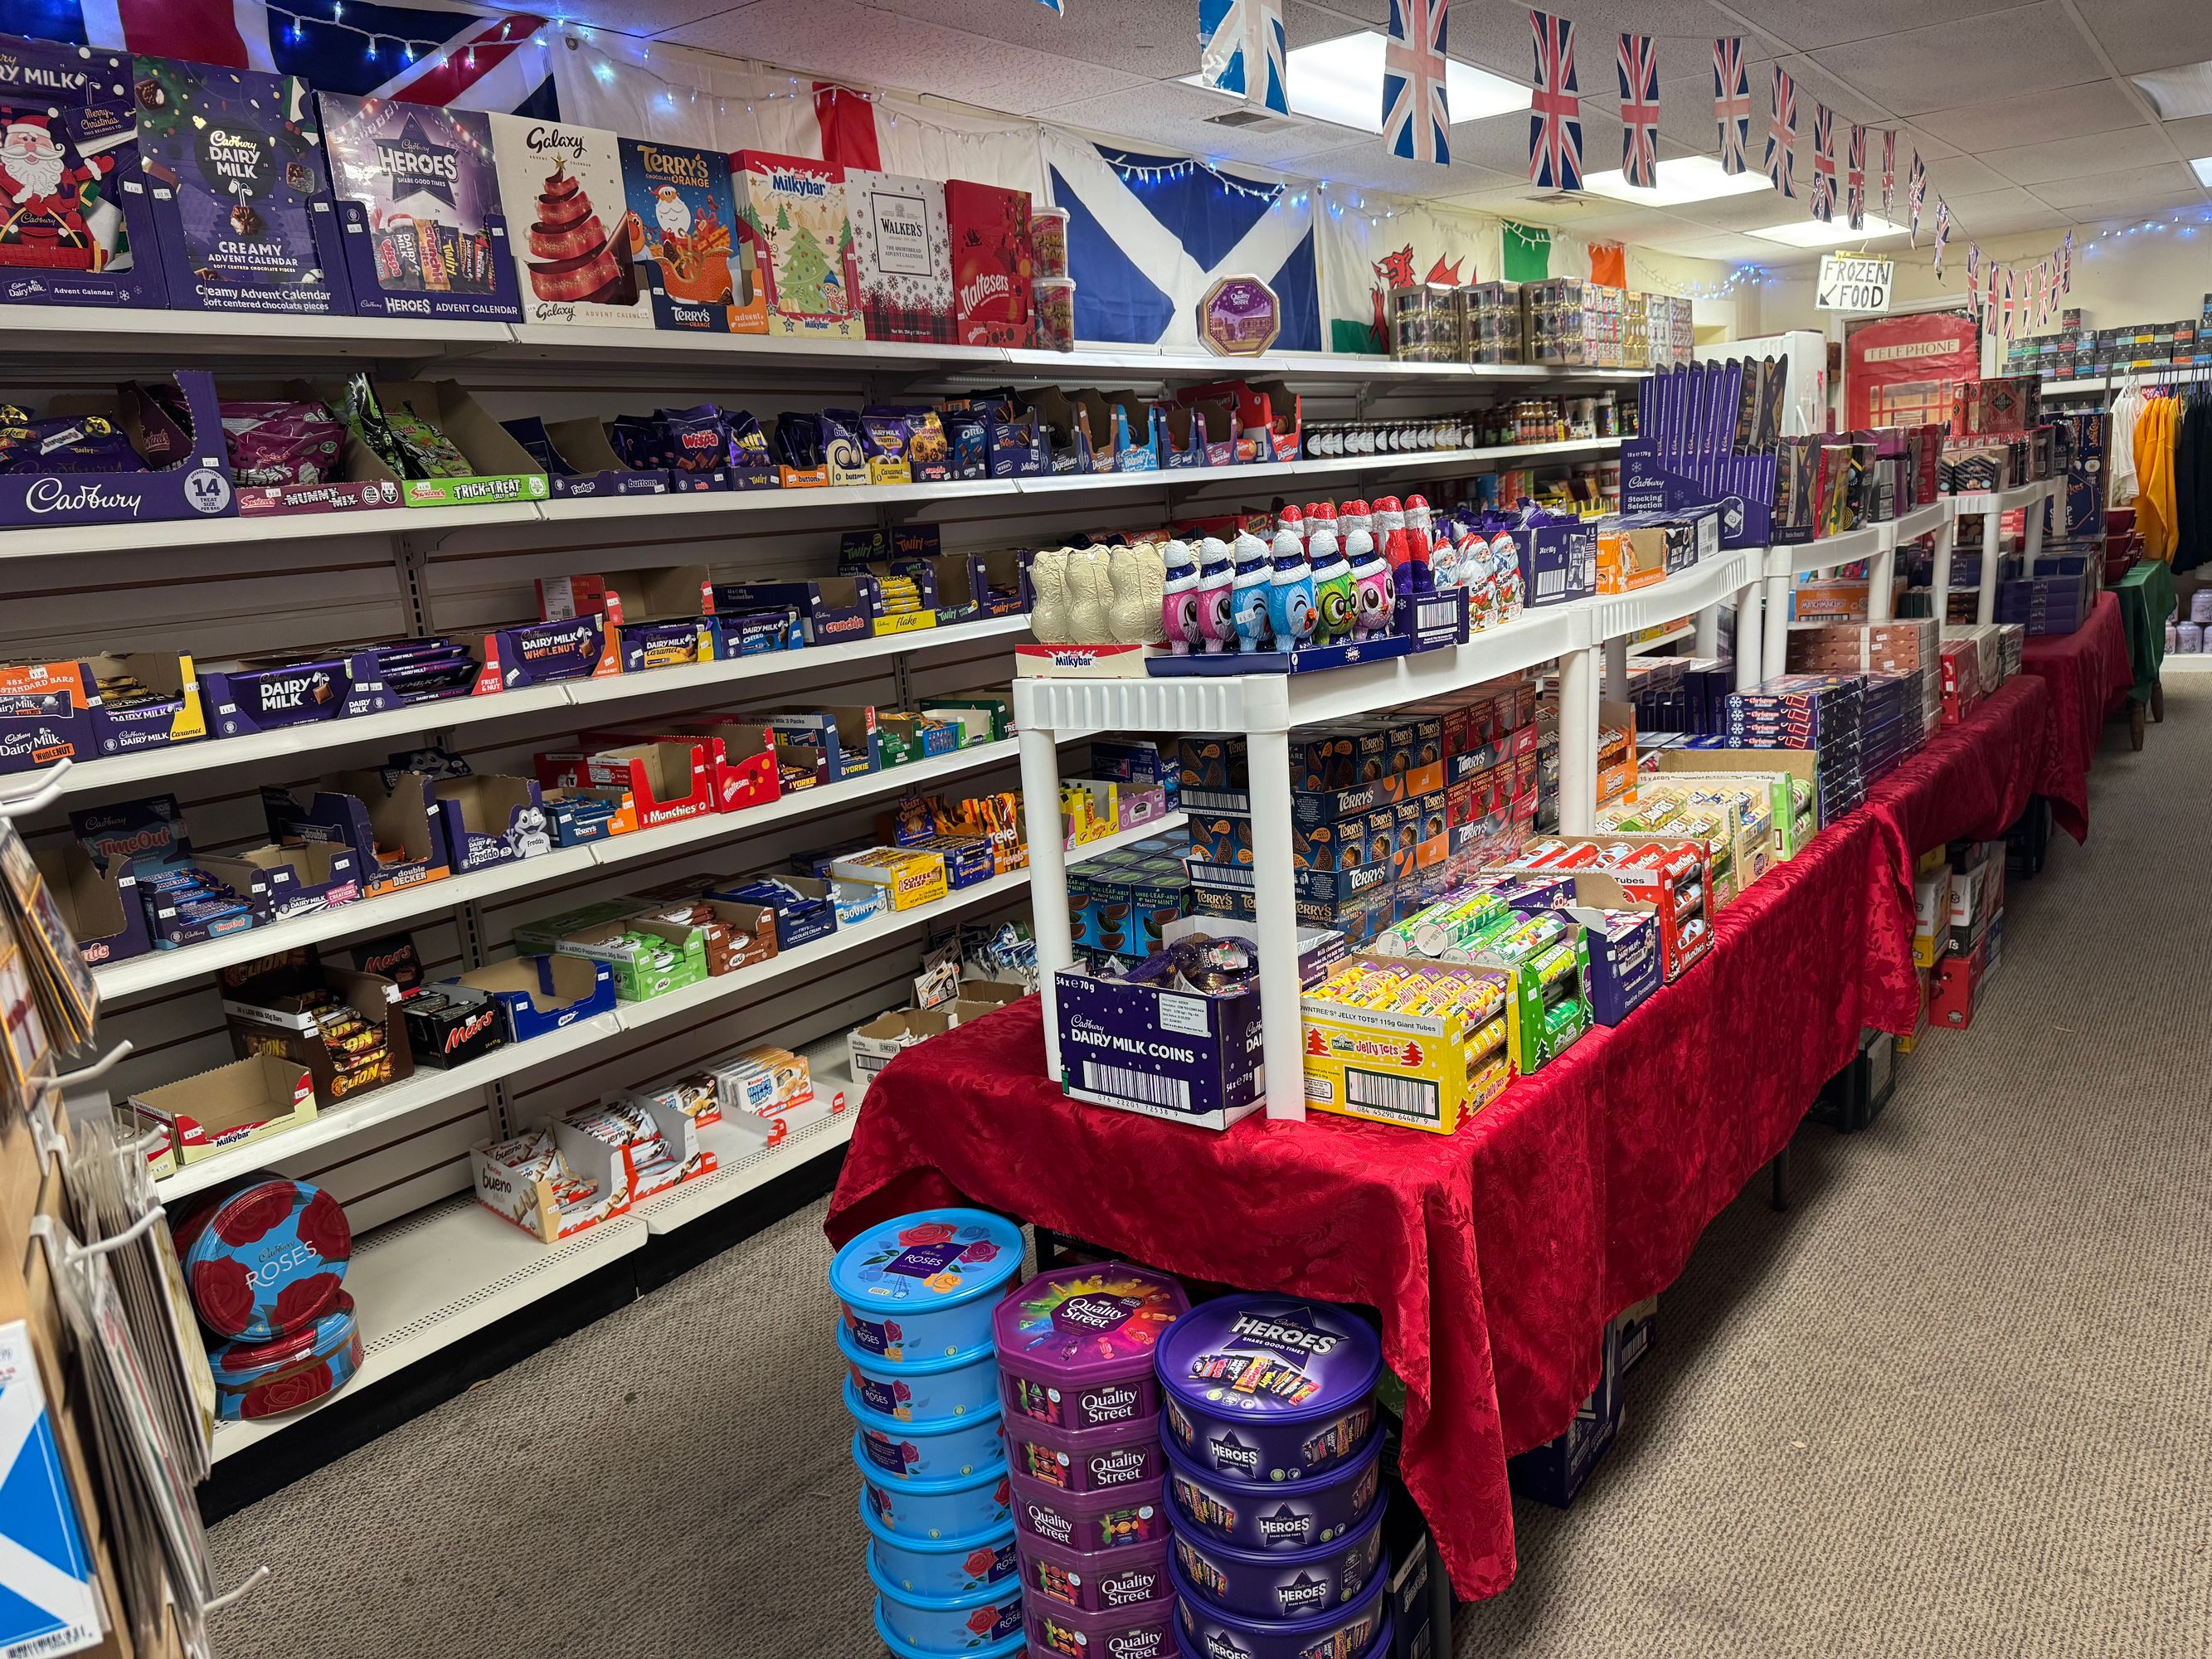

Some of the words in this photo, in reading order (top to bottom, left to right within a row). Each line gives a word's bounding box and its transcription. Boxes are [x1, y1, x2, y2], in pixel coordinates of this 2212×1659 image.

[24, 67, 77, 90] MILK
[85, 108, 109, 120] Merry
[80, 117, 119, 130] Christmas
[210, 130, 257, 153] Cadbury
[401, 139, 430, 153] Cadbury
[526, 127, 587, 158] Galaxy
[209, 146, 260, 164] DAIRY
[377, 145, 459, 182] HEROES
[637, 145, 709, 178] TERRY'S
[216, 161, 258, 179] MILK
[396, 177, 415, 185] SHARE
[414, 178, 430, 187] GOOD
[671, 174, 709, 188] ORANGE
[772, 175, 826, 197] Milkybar
[21, 212, 56, 226] Cadbury
[880, 217, 923, 238] WALKER'S
[218, 241, 282, 256] CREAMY
[208, 253, 247, 265] ADVENT
[248, 255, 299, 267] CALENDAR
[1824, 260, 1891, 285] FROZEN
[54, 287, 80, 295] Advent
[82, 288, 114, 297] Calendar
[195, 285, 239, 303] Creamy
[241, 288, 280, 300] Advent
[282, 289, 331, 302] Calendar
[960, 274, 1009, 316] Maltesers
[1230, 293, 1251, 302] Quality
[1839, 285, 1884, 308] FOOD
[203, 298, 222, 308] Soft
[222, 299, 260, 309] centered
[261, 300, 303, 311] chocolate
[304, 303, 329, 313] pieces
[360, 299, 382, 309] Cadbury
[385, 296, 431, 314] HEROES
[435, 302, 470, 314] ADVENT
[472, 304, 518, 315] CALENDAR
[1232, 298, 1249, 307] Street
[535, 304, 577, 321] Galaxy
[1870, 341, 1957, 360] TELEPHONE
[1051, 456, 1077, 472] Digestives
[192, 478, 221, 497] 14
[571, 481, 596, 495] Fudge
[628, 479, 657, 489] buttons
[1628, 475, 1665, 489] Cadbury
[26, 478, 141, 516] Cadbury
[284, 487, 338, 506] MUMMY
[331, 494, 359, 508] MIX
[1626, 500, 1663, 510] Selection
[1627, 493, 1663, 504] Stocking
[899, 538, 923, 552] Twirl
[990, 603, 1009, 615] Twirl
[742, 625, 761, 635] DAIRY
[762, 623, 779, 633] MILK
[826, 615, 864, 634] crunchie
[896, 615, 917, 630] flake
[522, 636, 553, 651] DAIRY
[553, 632, 578, 645] MILK
[646, 639, 666, 649] DAIRY
[667, 636, 686, 647] MILK
[524, 643, 576, 660] WHOLENUT
[646, 645, 678, 657] Caramel
[1055, 655, 1092, 669] Milkybar
[0, 679, 48, 693] STANDARD
[50, 675, 75, 685] BARS
[260, 678, 311, 698] DAIRY
[481, 678, 499, 687] FRUIT
[488, 683, 501, 692] NUT
[262, 692, 304, 711] MILK
[348, 698, 371, 709] DAIRY
[350, 705, 369, 715] MILK
[1748, 697, 1777, 705] Christmas
[4, 732, 31, 744] Cadbury
[119, 730, 146, 741] Cadbury
[120, 736, 147, 747] DAIRY
[147, 732, 169, 741] MILK
[171, 727, 202, 738] Caramel
[0, 741, 33, 757] Dairy
[33, 733, 61, 748] Milk
[35, 746, 71, 761] WHOLENUT
[845, 762, 869, 774] YORKIE
[1457, 750, 1485, 775] TERRY'S
[722, 777, 750, 802] Maltesers
[649, 802, 698, 823] Munchies
[573, 824, 598, 836] TERRY'S
[610, 818, 625, 830] milk
[469, 847, 499, 865] Freddo
[1665, 852, 1697, 874] Munchies
[392, 870, 427, 888] DECKER
[398, 865, 425, 877] double
[903, 872, 931, 885] COFFEE
[1349, 866, 1386, 889] TERRY'S
[290, 898, 309, 909] DAIRY
[309, 895, 326, 905] MILK
[1194, 888, 1232, 906] TERRY'S
[843, 902, 875, 922] BOUNTY
[365, 945, 412, 974] Mars
[1071, 1014, 1105, 1034] Cadbury
[1338, 1010, 1357, 1020] JELLY
[1379, 1019, 1396, 1029] 115g
[1397, 1020, 1414, 1029] Giant
[1416, 1023, 1437, 1032] Tubes
[444, 1010, 493, 1054] Mars
[1071, 1029, 1112, 1048] DAIRY
[1113, 1038, 1148, 1056] MILK
[1148, 1044, 1194, 1064] COINS
[1356, 1041, 1378, 1055] Jelly
[1379, 1044, 1399, 1056] Tots
[216, 1130, 250, 1148] Milkybar
[482, 1168, 513, 1195] bueno
[246, 1239, 318, 1292] ROSES
[904, 1253, 943, 1267] ROSES
[1067, 1297, 1128, 1321] Quality
[1061, 1308, 1110, 1329] Street
[857, 1330, 880, 1345] ROSES
[1229, 1316, 1338, 1355] HEROES
[865, 1389, 888, 1405] ROSES
[1082, 1389, 1137, 1411] Quality
[1088, 1405, 1133, 1423] Street
[1091, 1453, 1146, 1473] Quality
[1211, 1443, 1257, 1466] HEROES
[1096, 1467, 1141, 1486] Street
[1028, 1505, 1072, 1534] Quality
[1260, 1517, 1310, 1534] HEROES
[1034, 1520, 1070, 1545] Street
[1101, 1574, 1156, 1595] Quality
[1278, 1583, 1327, 1604] HEROES
[1108, 1588, 1152, 1607] Street
[1108, 1632, 1162, 1652] Quality
